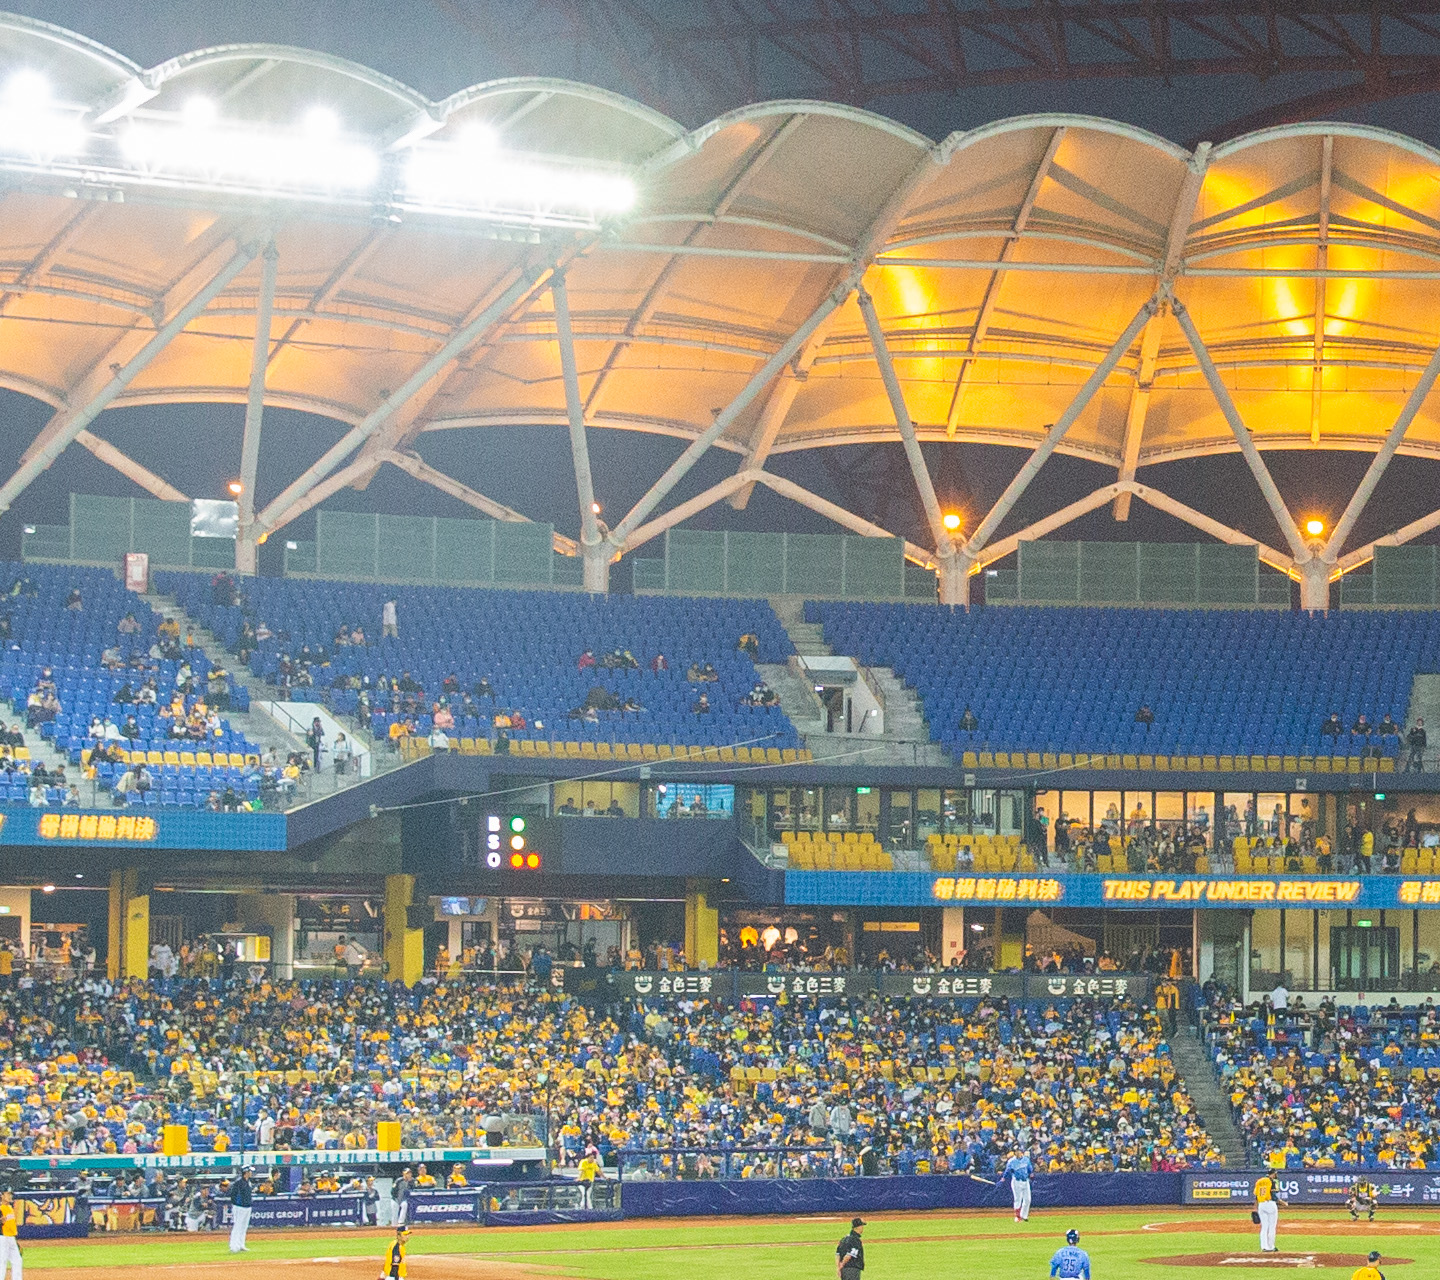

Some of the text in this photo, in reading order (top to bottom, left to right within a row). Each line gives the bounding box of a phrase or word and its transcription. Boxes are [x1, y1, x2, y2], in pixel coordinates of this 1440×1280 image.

[488, 816, 500, 832] B
[488, 834, 500, 850] S
[487, 852, 501, 868] O
[1103, 880, 1360, 901] THIS PLAY UNDER REVIEW
[659, 977, 712, 993] 金色三麥
[792, 977, 846, 993] 金色三麥
[938, 978, 993, 995] 金色三麥
[276, 1210, 303, 1219] GROUP
[415, 1204, 474, 1214] SKECHERS
[1063, 1258, 1076, 1272] 35
